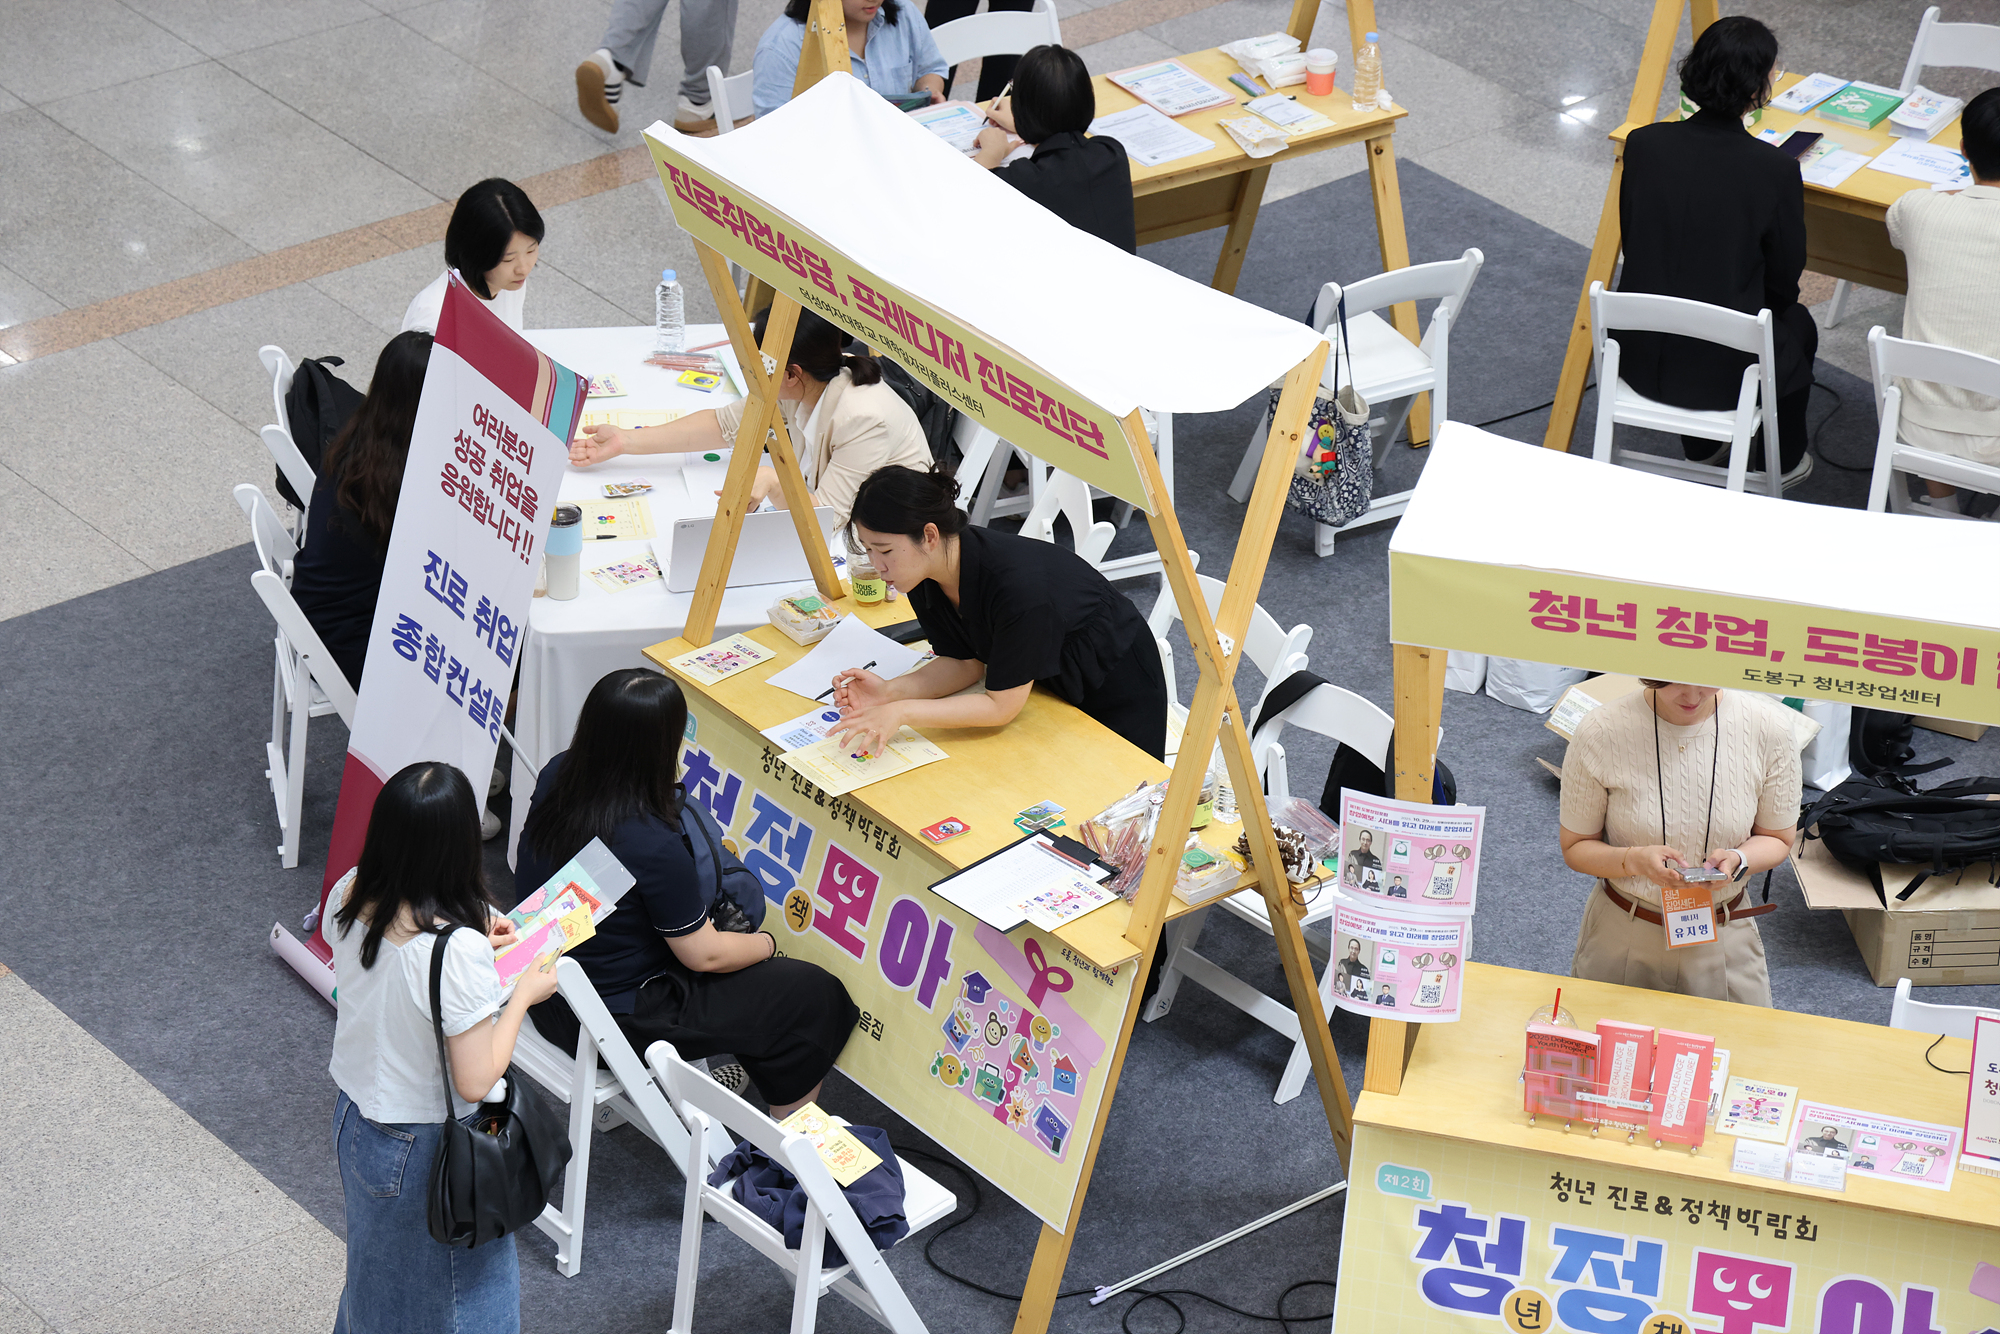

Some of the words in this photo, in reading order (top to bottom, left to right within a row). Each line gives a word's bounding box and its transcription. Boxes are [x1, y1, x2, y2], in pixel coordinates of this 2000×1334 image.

[662, 159, 849, 307] 진로취업상담,
[847, 274, 971, 384] 프레디저
[974, 352, 1109, 460] 진로진단
[799, 286, 878, 341] 덕성여자대학교
[879, 333, 986, 419] 대학일자리플러스센터
[472, 403, 535, 475] 여러분의
[453, 429, 486, 477] 성공
[489, 459, 538, 523] 취업을
[440, 463, 535, 565] 응원합니다!!
[855, 583, 872, 592] TOUS
[858, 588, 877, 597] JOURS
[422, 549, 468, 620] 진로
[473, 594, 518, 668] 취업
[1528, 589, 1637, 642] 청년
[1655, 606, 1785, 662] 창업,
[1804, 626, 1978, 686] 도봉이
[1743, 667, 1806, 689] 도봉구
[1812, 673, 1941, 708] 청년창업센터
[761, 746, 787, 782] 청년
[1664, 889, 1679, 901] 청년
[1666, 898, 1696, 912] 창업센터
[857, 1010, 886, 1042] 음집
[1550, 1035, 1595, 1052] Dobong-gu
[1537, 1040, 1560, 1048] Youth
[1560, 1043, 1587, 1054] Project
[1625, 1045, 1635, 1072] FUTURE!
[1612, 1047, 1624, 1085] CHALLENGE
[1987, 1062, 2000, 1074] 도
[1664, 1103, 1674, 1123] YOUR
[1669, 1058, 1685, 1101] CHALLENGE
[1675, 1088, 1689, 1120] GROWTH
[1684, 1057, 1696, 1086] FUTURE!
[1984, 1079, 2000, 1096] 청
[1384, 1174, 1425, 1193] 제2회
[1550, 1171, 1596, 1205] 청년
[1607, 1184, 1819, 1243] 진로&정책박람회
